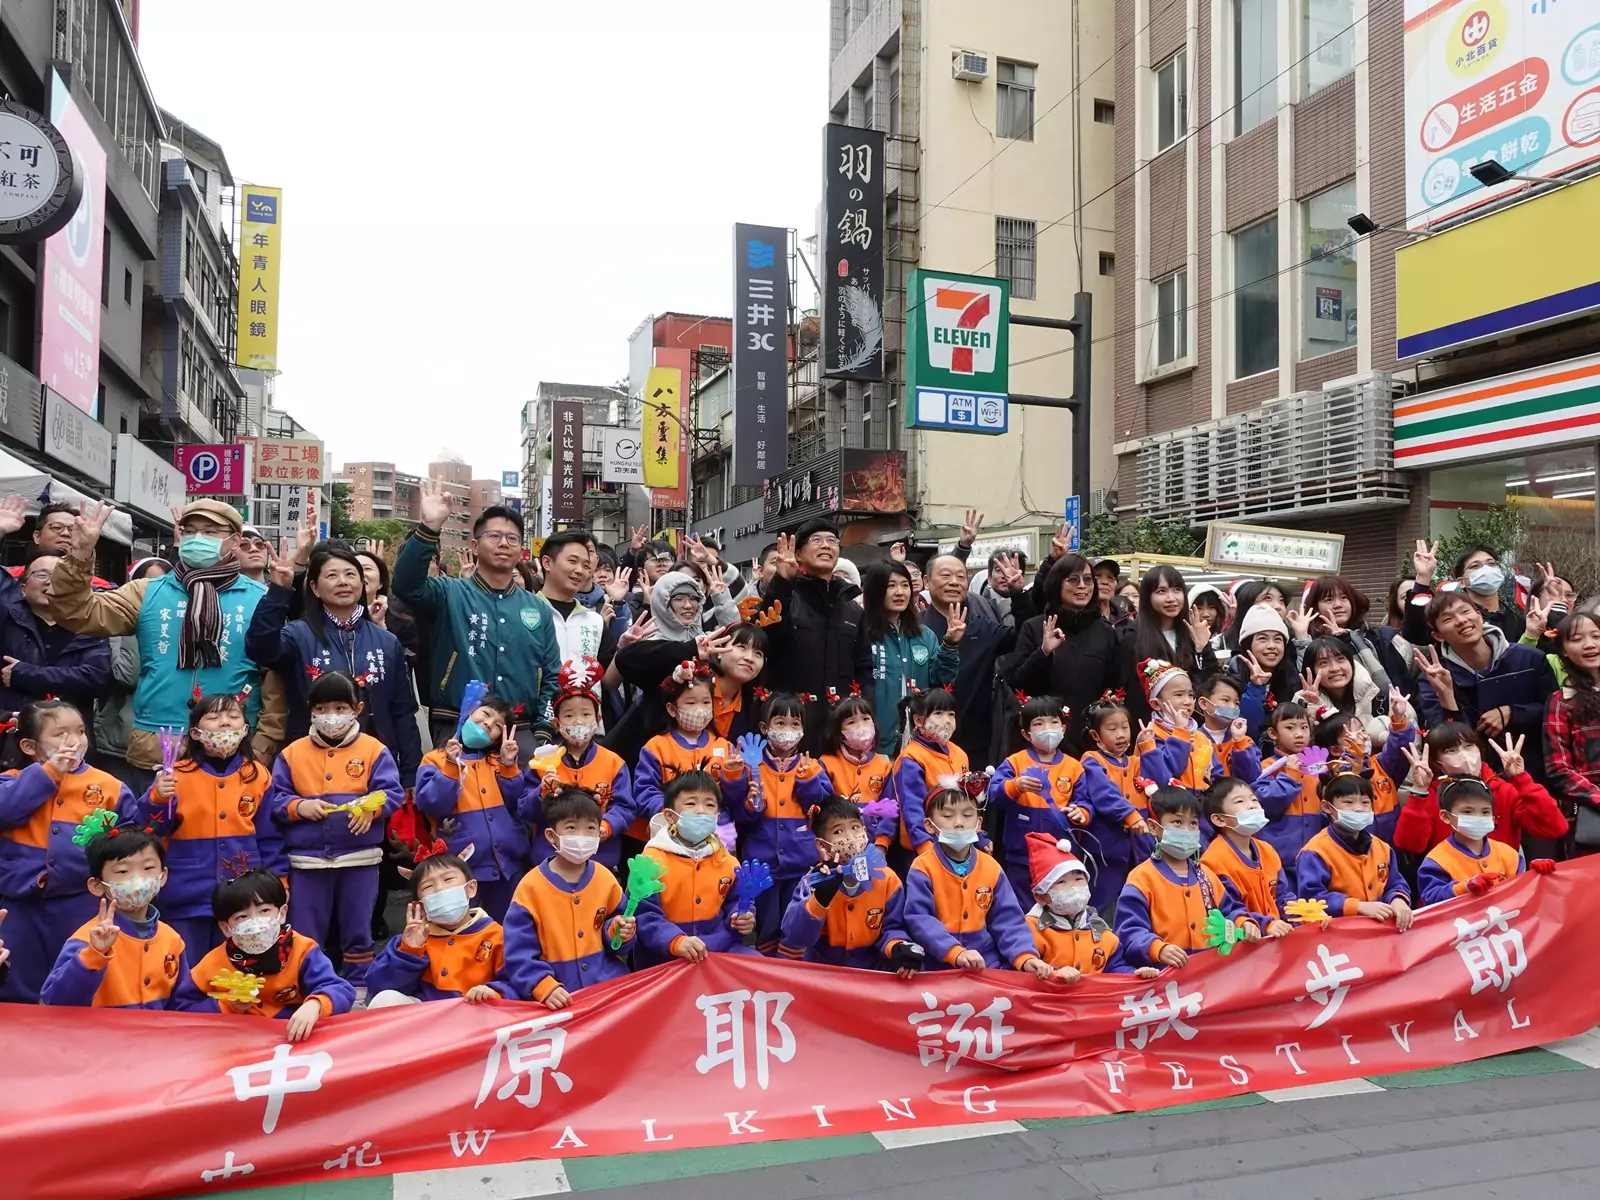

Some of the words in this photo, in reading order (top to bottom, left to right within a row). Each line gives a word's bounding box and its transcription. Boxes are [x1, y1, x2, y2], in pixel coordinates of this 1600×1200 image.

[1455, 38, 1498, 68] 小北百貨
[1460, 73, 1538, 125] 生活五金
[0, 170, 40, 190] 紅茶
[838, 144, 872, 250] 羽の鍋
[249, 233, 269, 338] 年青人眼鏡
[747, 278, 775, 351] 三井3C
[952, 398, 972, 408] ATM
[980, 408, 1001, 418] Wi-Fi
[653, 387, 674, 466] 八方雲集
[199, 456, 215, 480] P
[261, 443, 319, 464] 夢工場
[562, 411, 574, 489] 非凡比驗光所
[223, 448, 232, 491] 機車停車場
[259, 465, 320, 481] 數位影像
[287, 485, 300, 522] 代眼鏡
[1247, 540, 1329, 558] 恐龍愛吃雞蛋糕
[235, 605, 245, 634] 市議員
[225, 906, 1528, 1134] 中原耶誕散步節
[448, 1085, 998, 1158] WALKING
[1102, 997, 1531, 1093] FESTIVAL
